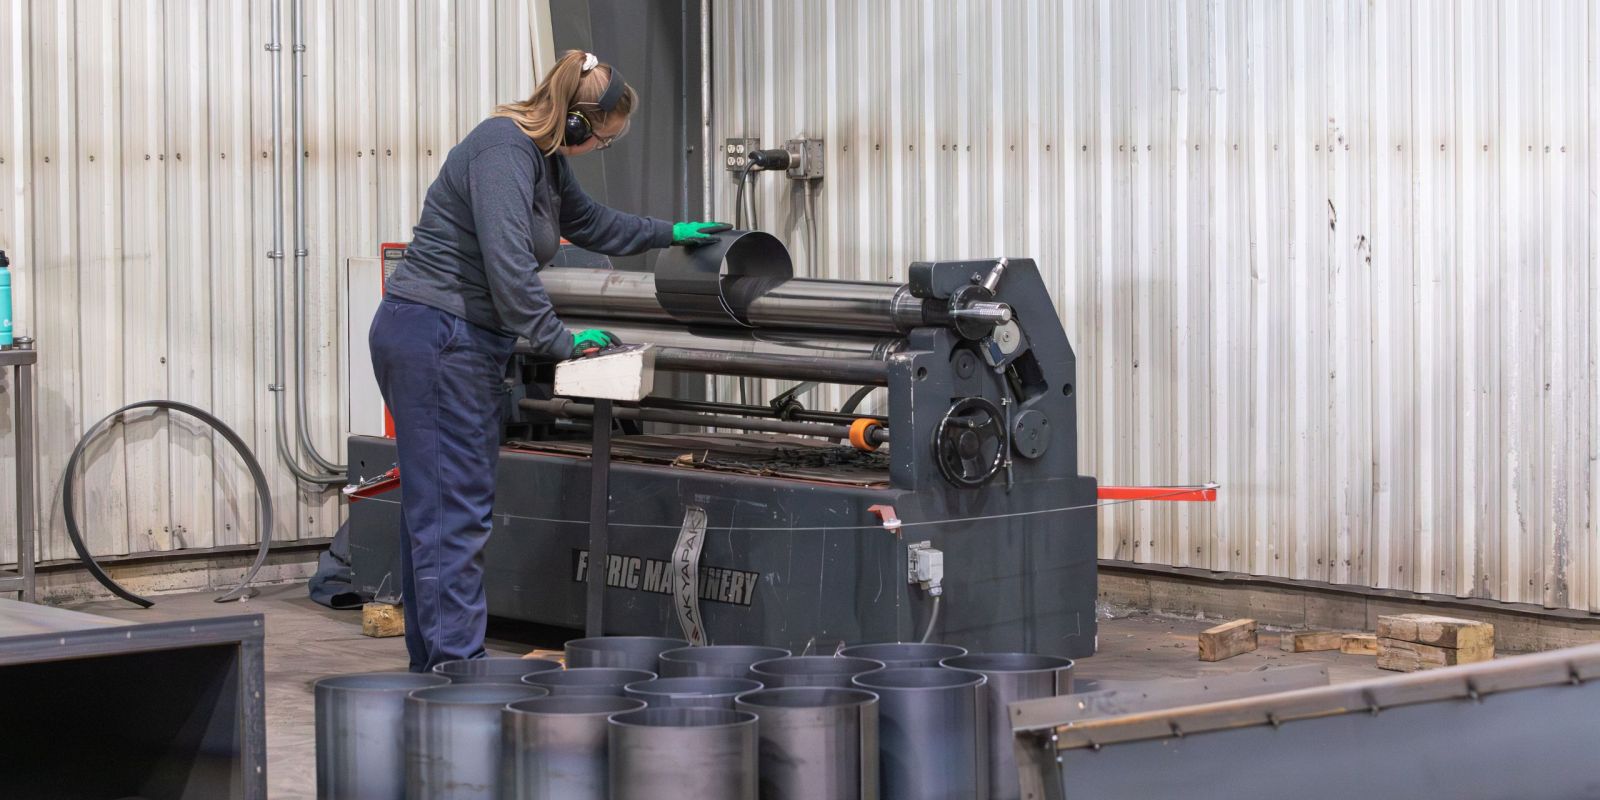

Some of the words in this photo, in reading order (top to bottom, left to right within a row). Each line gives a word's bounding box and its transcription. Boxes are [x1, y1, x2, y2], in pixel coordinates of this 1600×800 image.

[576, 550, 641, 590] FRIC
[643, 559, 759, 605] MAINERY
[681, 517, 702, 624] AKYAPAK
